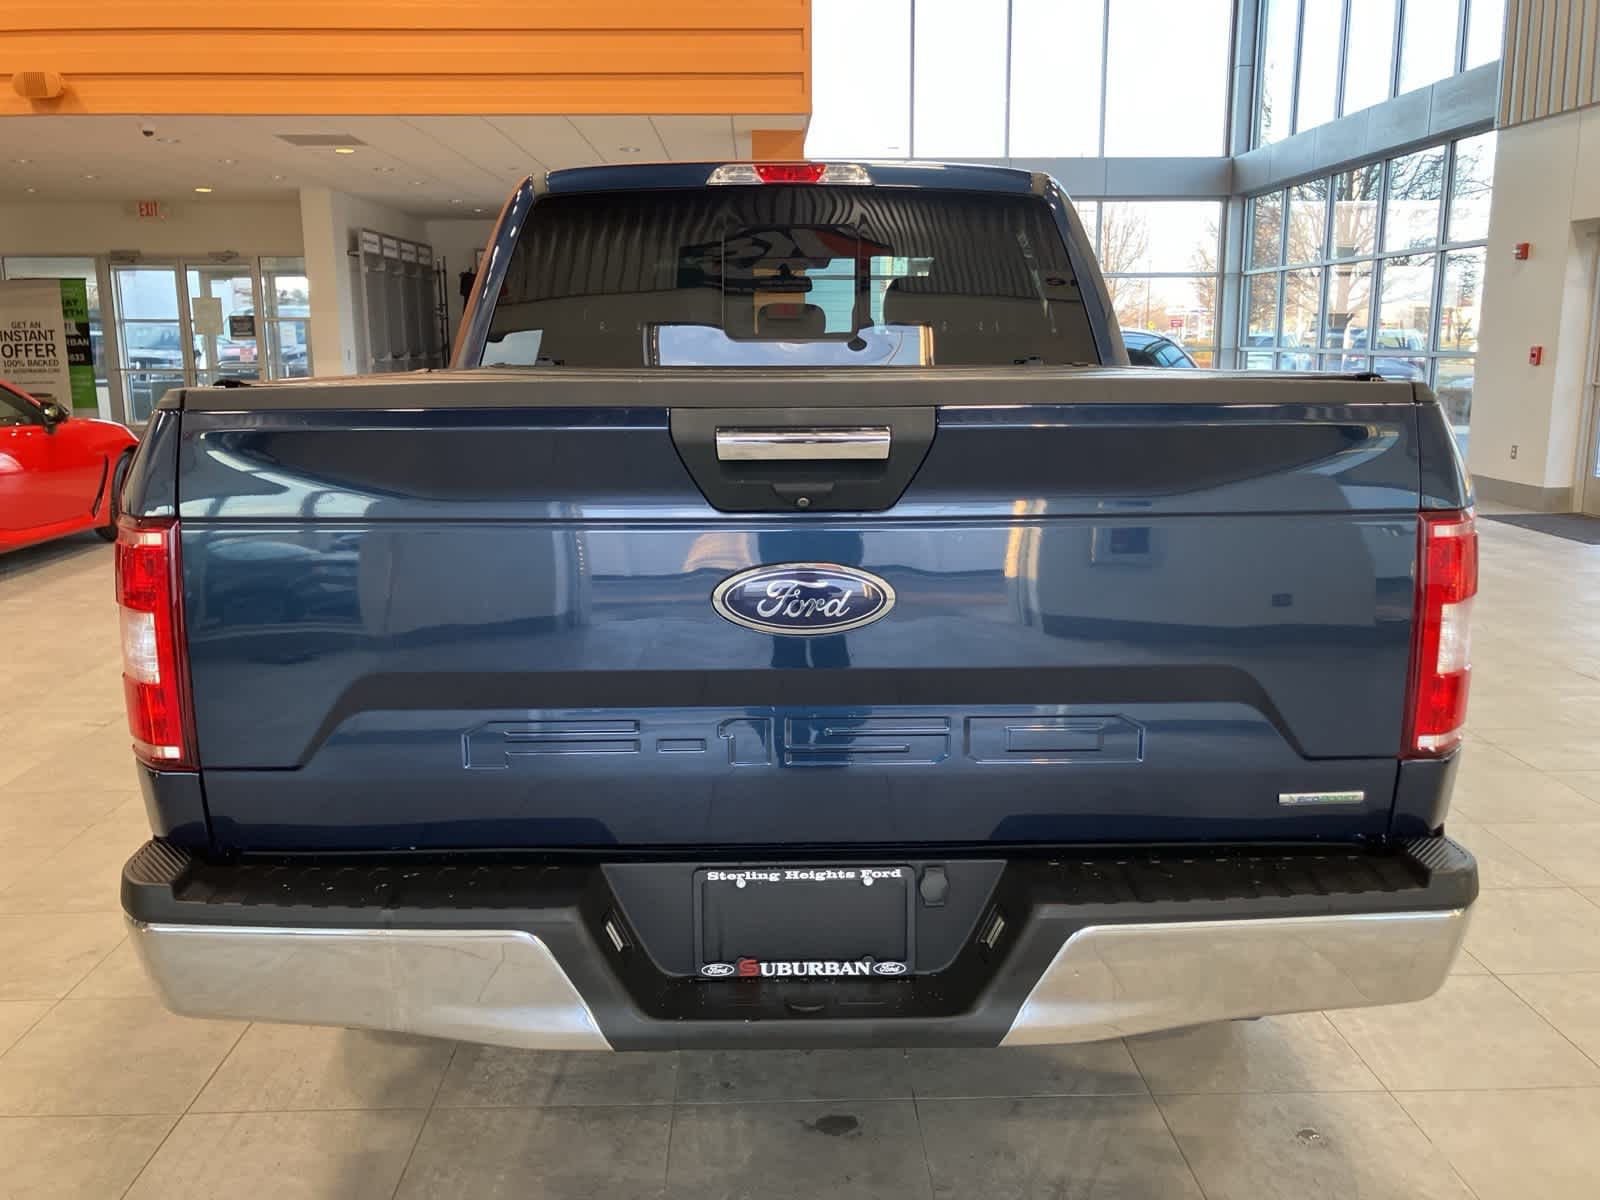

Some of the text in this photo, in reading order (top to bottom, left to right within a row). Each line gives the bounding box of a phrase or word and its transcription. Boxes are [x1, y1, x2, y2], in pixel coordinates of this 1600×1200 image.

[138, 201, 158, 217] EXIT
[11, 321, 41, 329] GET AN
[0, 330, 55, 342] INSTANT
[1, 343, 57, 358] OFFER
[4, 359, 59, 368] 100% BACKED
[757, 579, 853, 617] Ford
[462, 715, 1144, 769] F-150
[707, 869, 901, 881] Sterling Heights Ford
[738, 959, 871, 976] SUBURBAN
